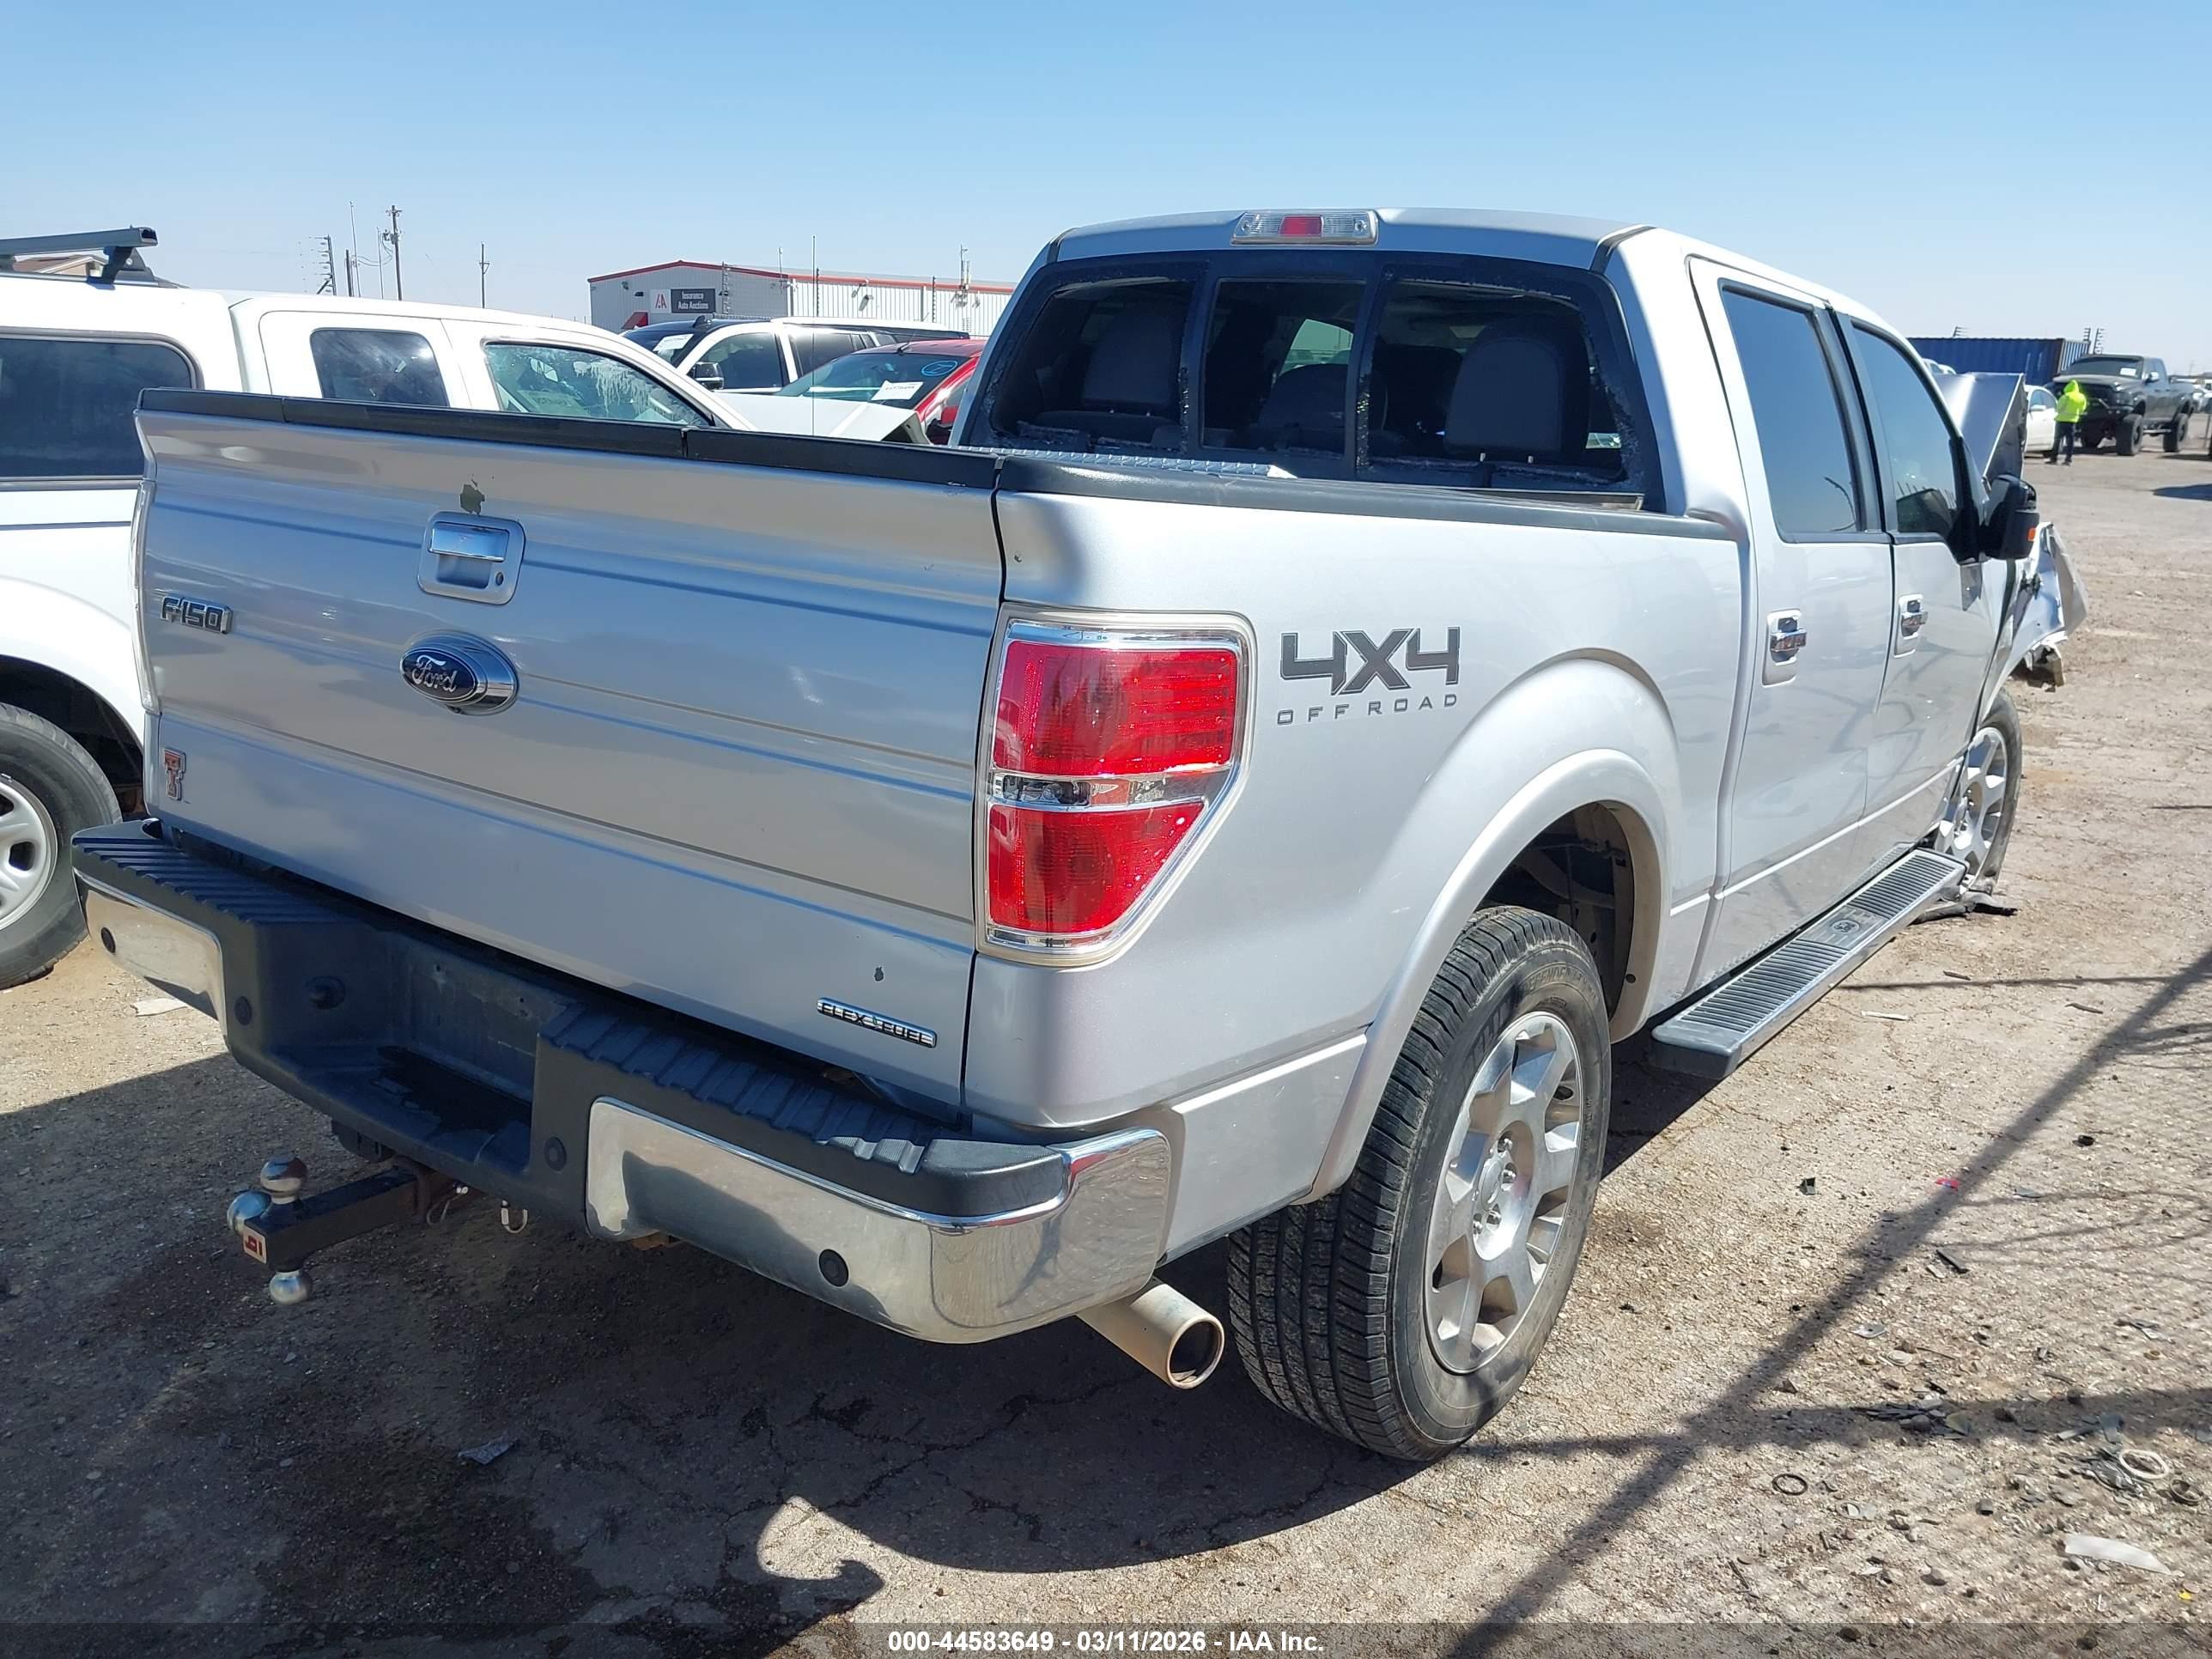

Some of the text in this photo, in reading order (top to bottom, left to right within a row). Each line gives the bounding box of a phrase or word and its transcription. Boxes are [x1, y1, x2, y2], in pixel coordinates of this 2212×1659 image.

[678, 301, 709, 310] Auto Auctions
[410, 653, 459, 694] Ford
[1277, 693, 1459, 726] OFF ROAD
